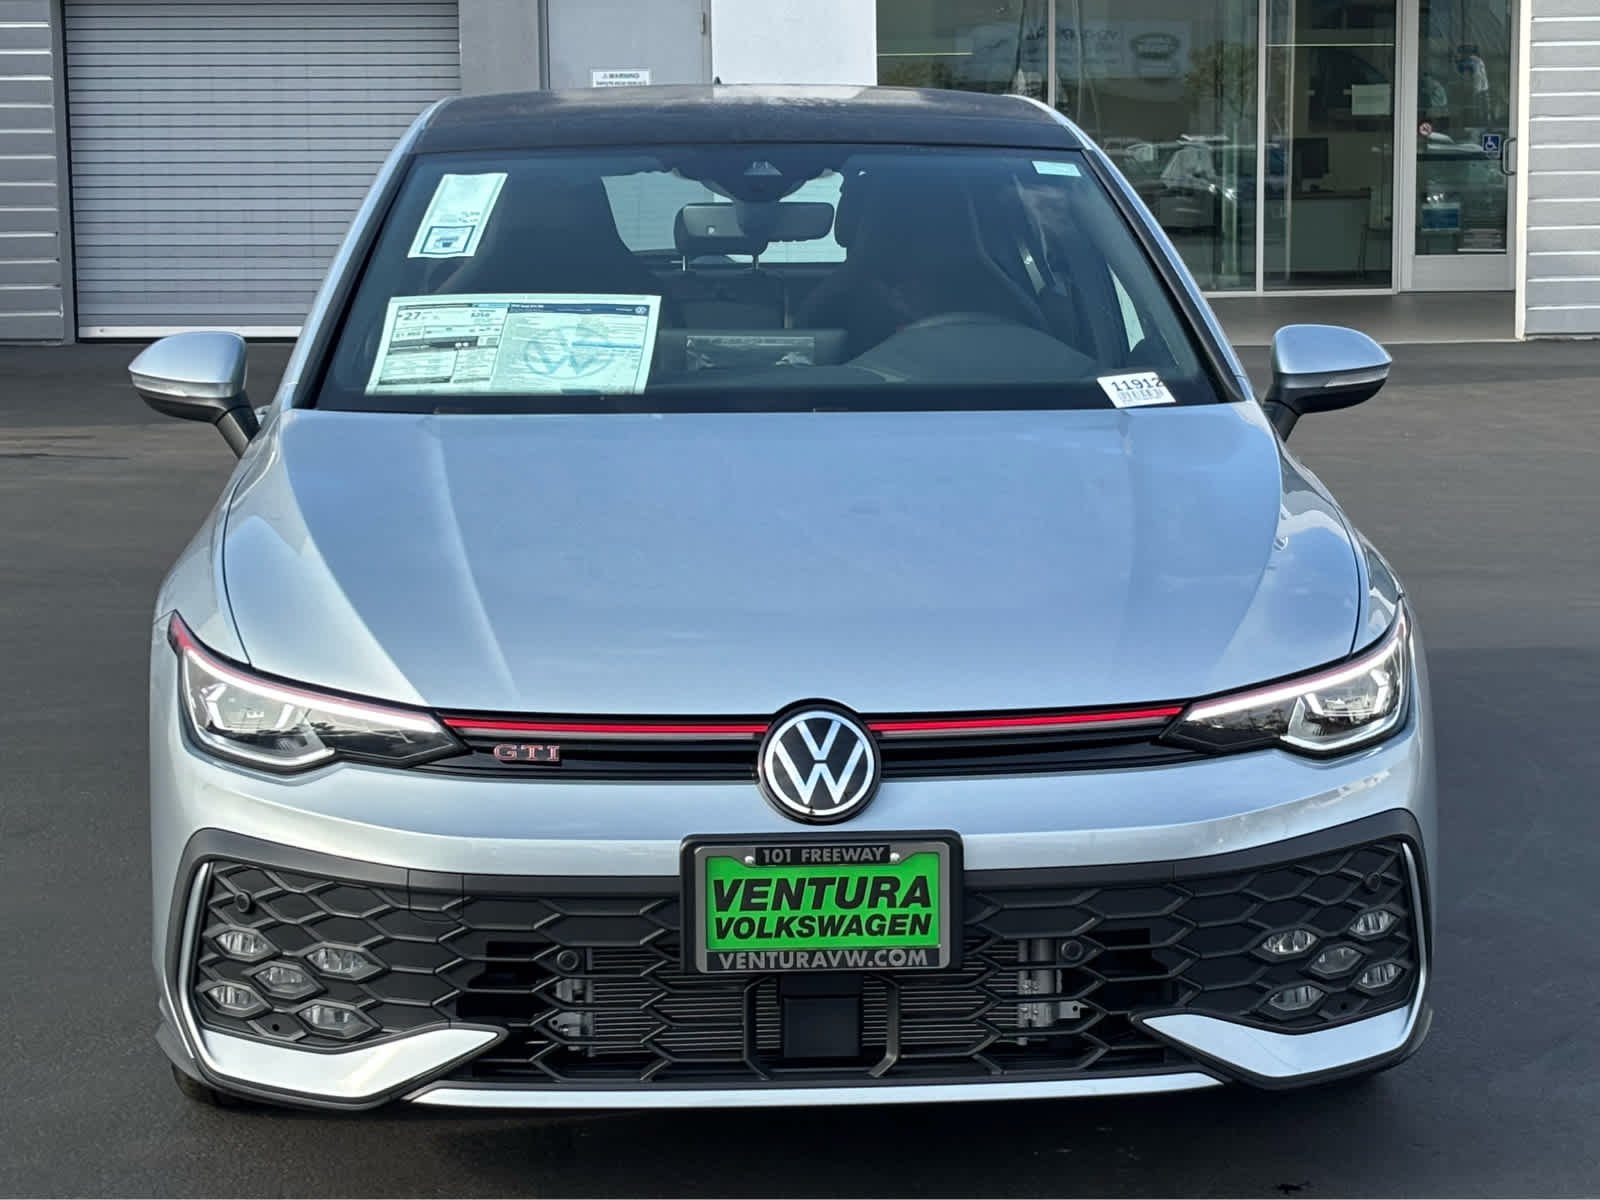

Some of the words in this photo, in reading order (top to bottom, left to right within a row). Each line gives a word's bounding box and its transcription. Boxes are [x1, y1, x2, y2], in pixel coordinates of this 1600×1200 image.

[1111, 377, 1164, 391] 11912
[493, 743, 561, 762] GTI
[771, 716, 869, 808] VW
[762, 848, 792, 864] 101
[801, 846, 886, 863] FREEWAY
[713, 875, 932, 912] VENTURA
[715, 913, 932, 940] VOLKSWAGEN
[718, 948, 928, 970] VENTURAVW.COM
